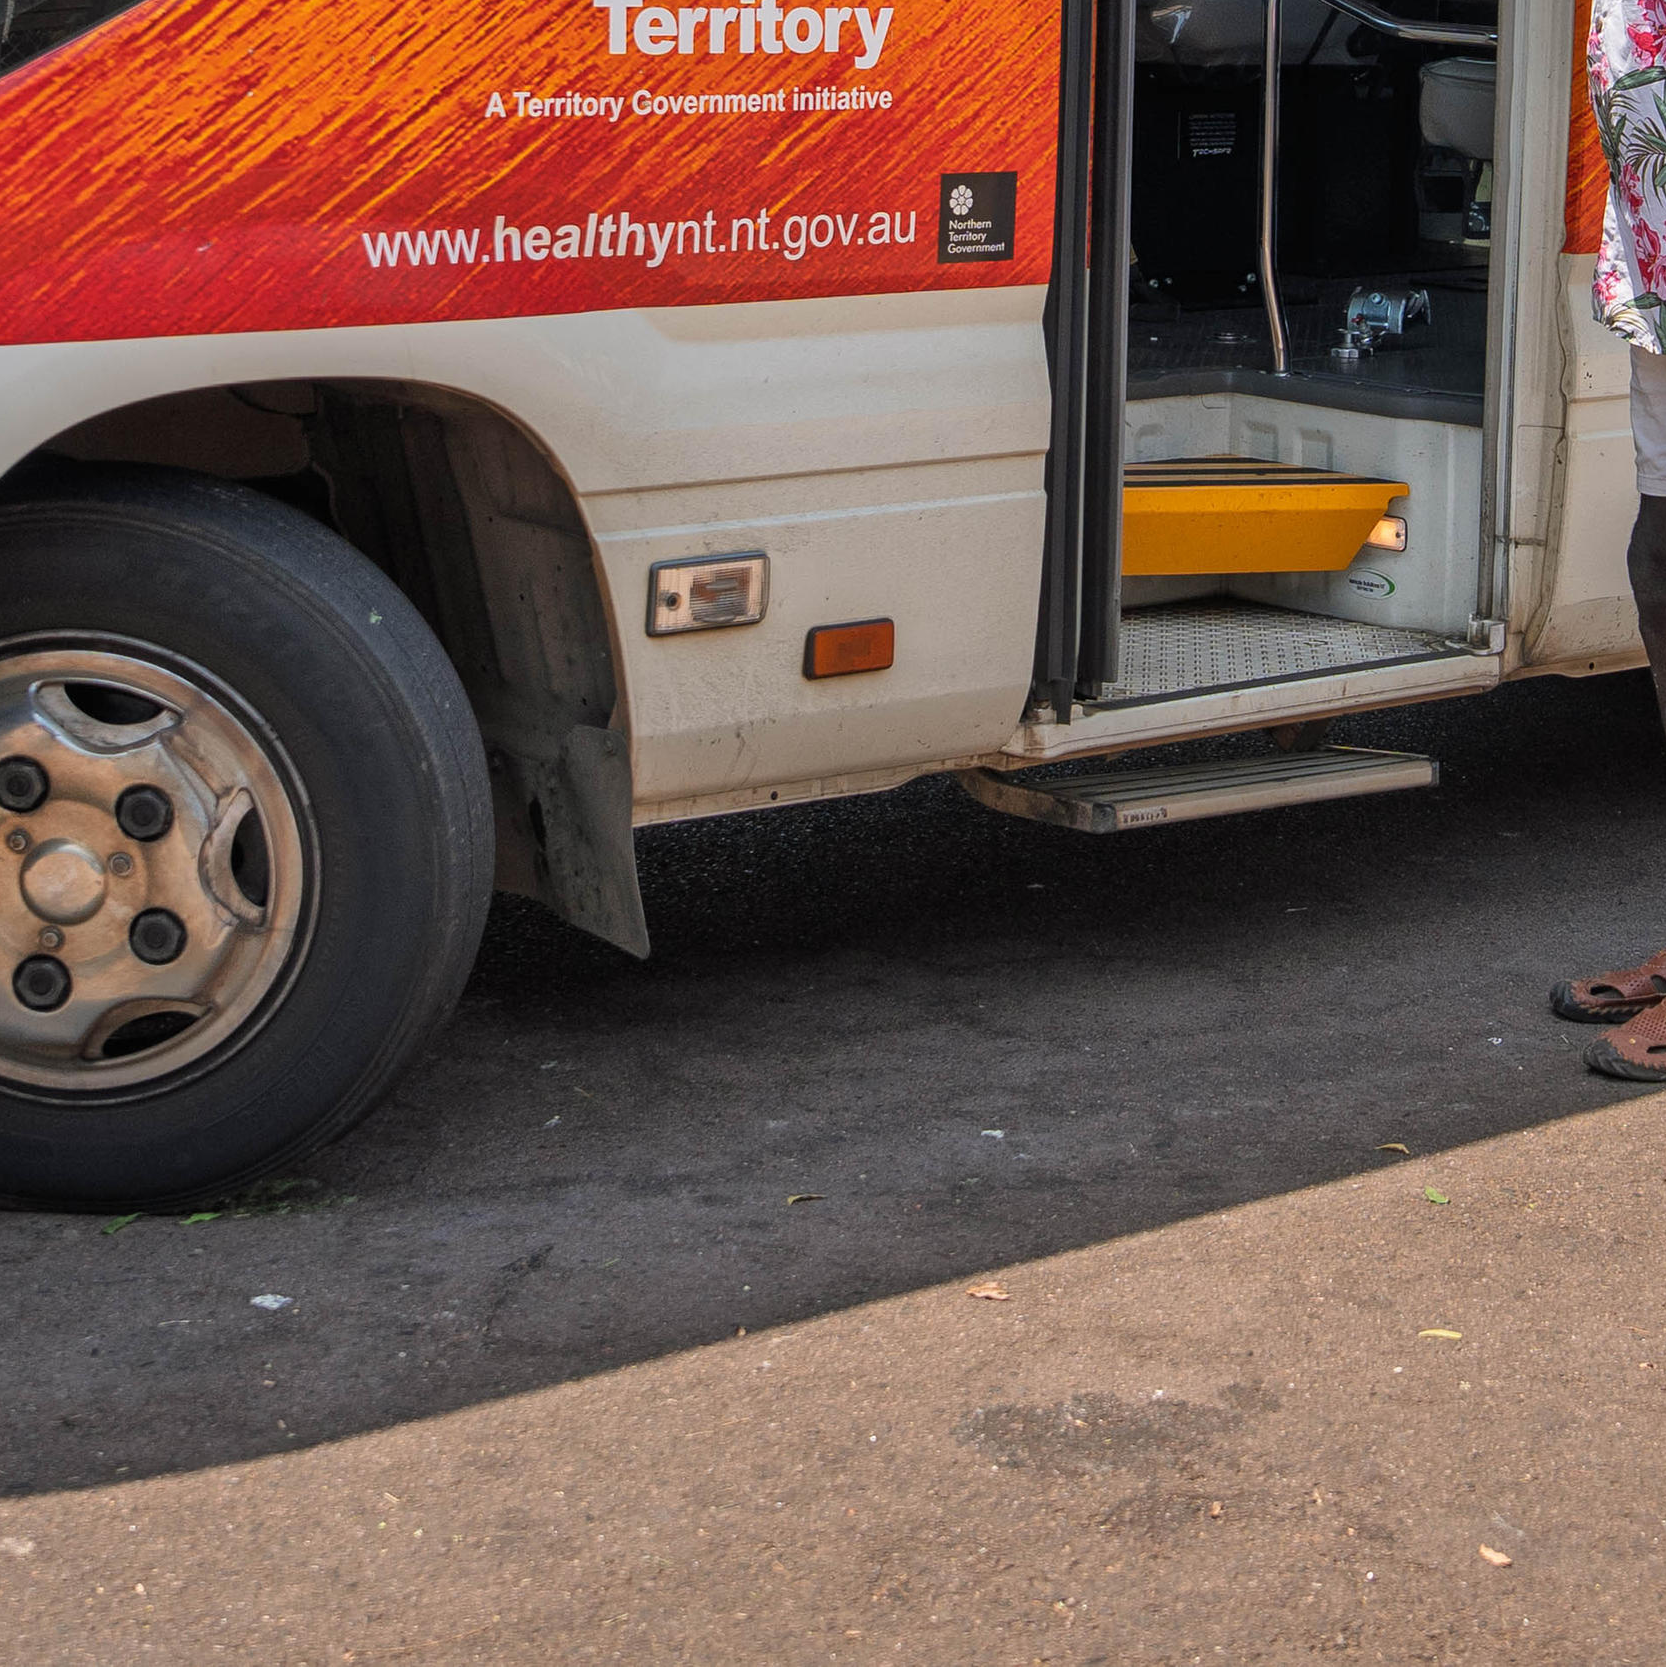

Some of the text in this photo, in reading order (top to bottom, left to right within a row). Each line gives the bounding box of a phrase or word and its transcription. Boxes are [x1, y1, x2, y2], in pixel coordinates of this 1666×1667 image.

[485, 85, 893, 122] A Territory Government initiative
[948, 219, 992, 230] Northern
[362, 206, 917, 268] www.healthynt.nt.gov.au
[949, 231, 987, 243] Territory
[947, 242, 1005, 254] Government
